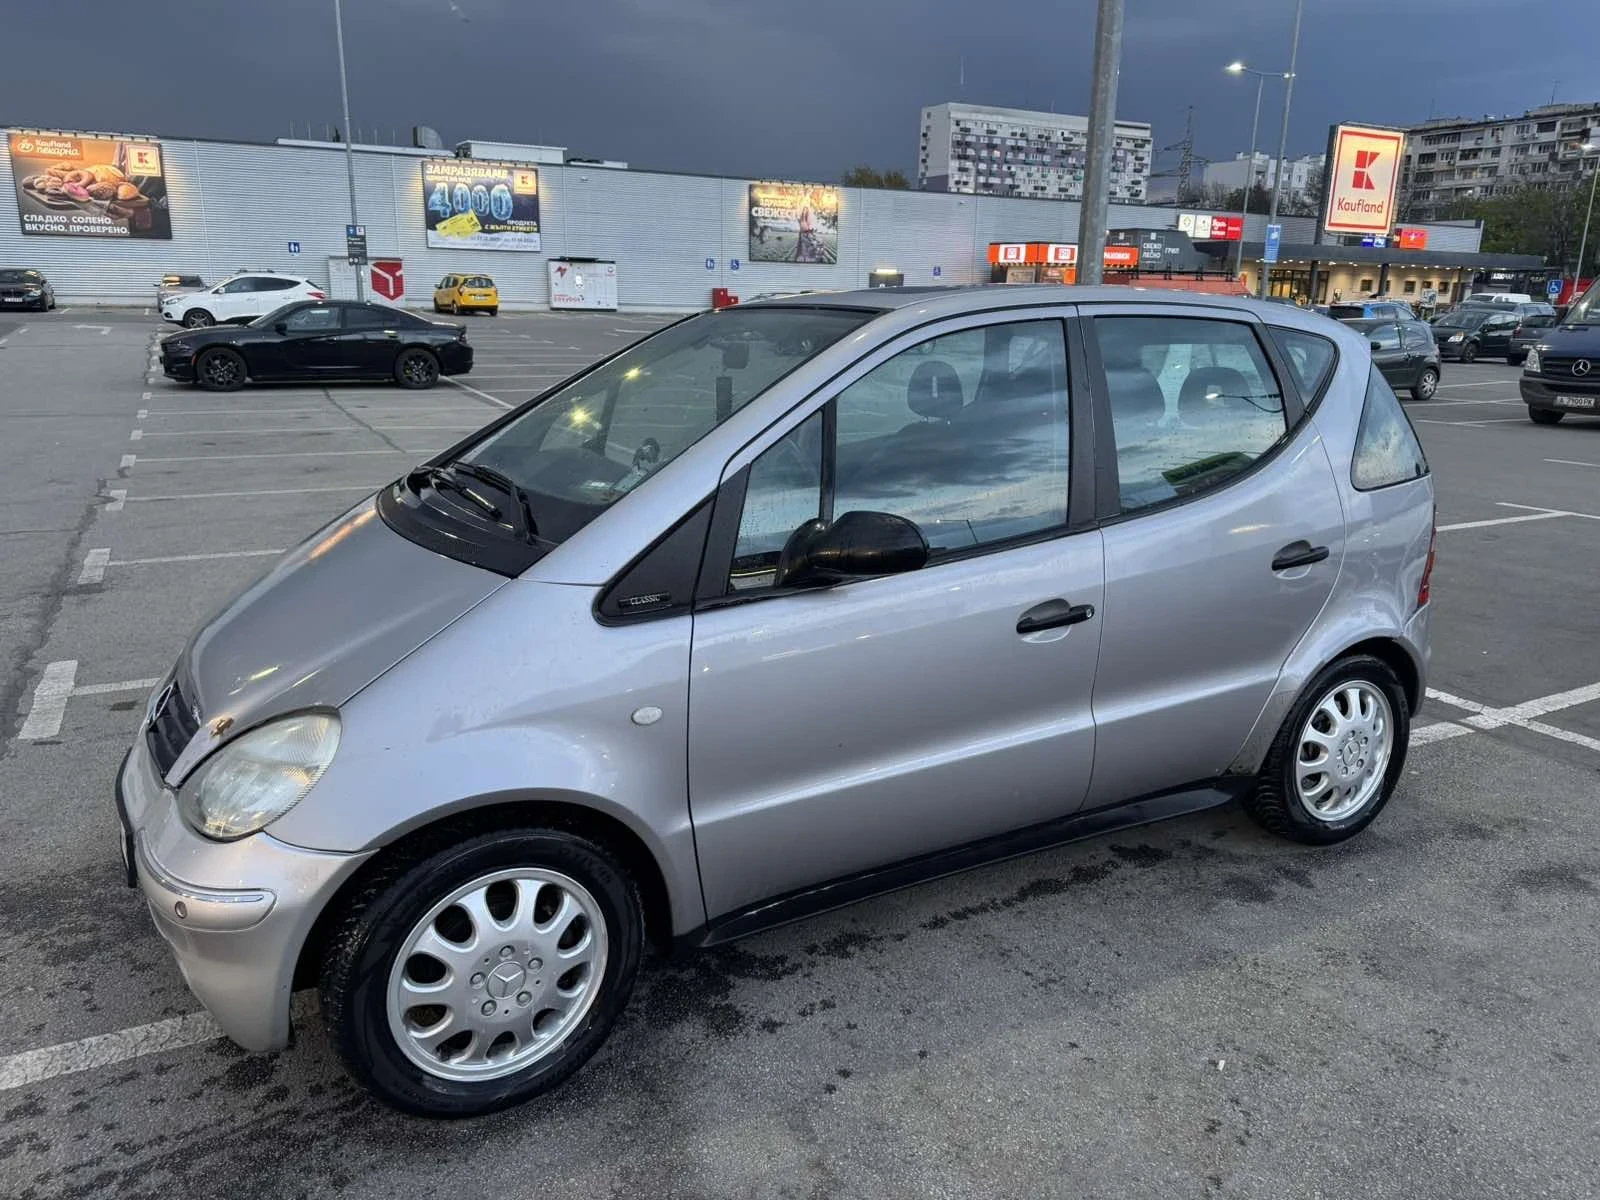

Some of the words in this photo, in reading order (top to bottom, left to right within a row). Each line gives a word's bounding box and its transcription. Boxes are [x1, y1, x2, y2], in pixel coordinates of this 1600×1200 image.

[428, 182, 513, 220] 4000
[1337, 197, 1384, 214] Kaufland
[24, 214, 70, 223] СЛАДКО.
[72, 216, 114, 225] СОЛЕНО.
[25, 223, 69, 232] ВКУСНО.
[70, 225, 130, 234] ПРОВЕРЕНО.
[630, 595, 660, 605] CLASSIC
